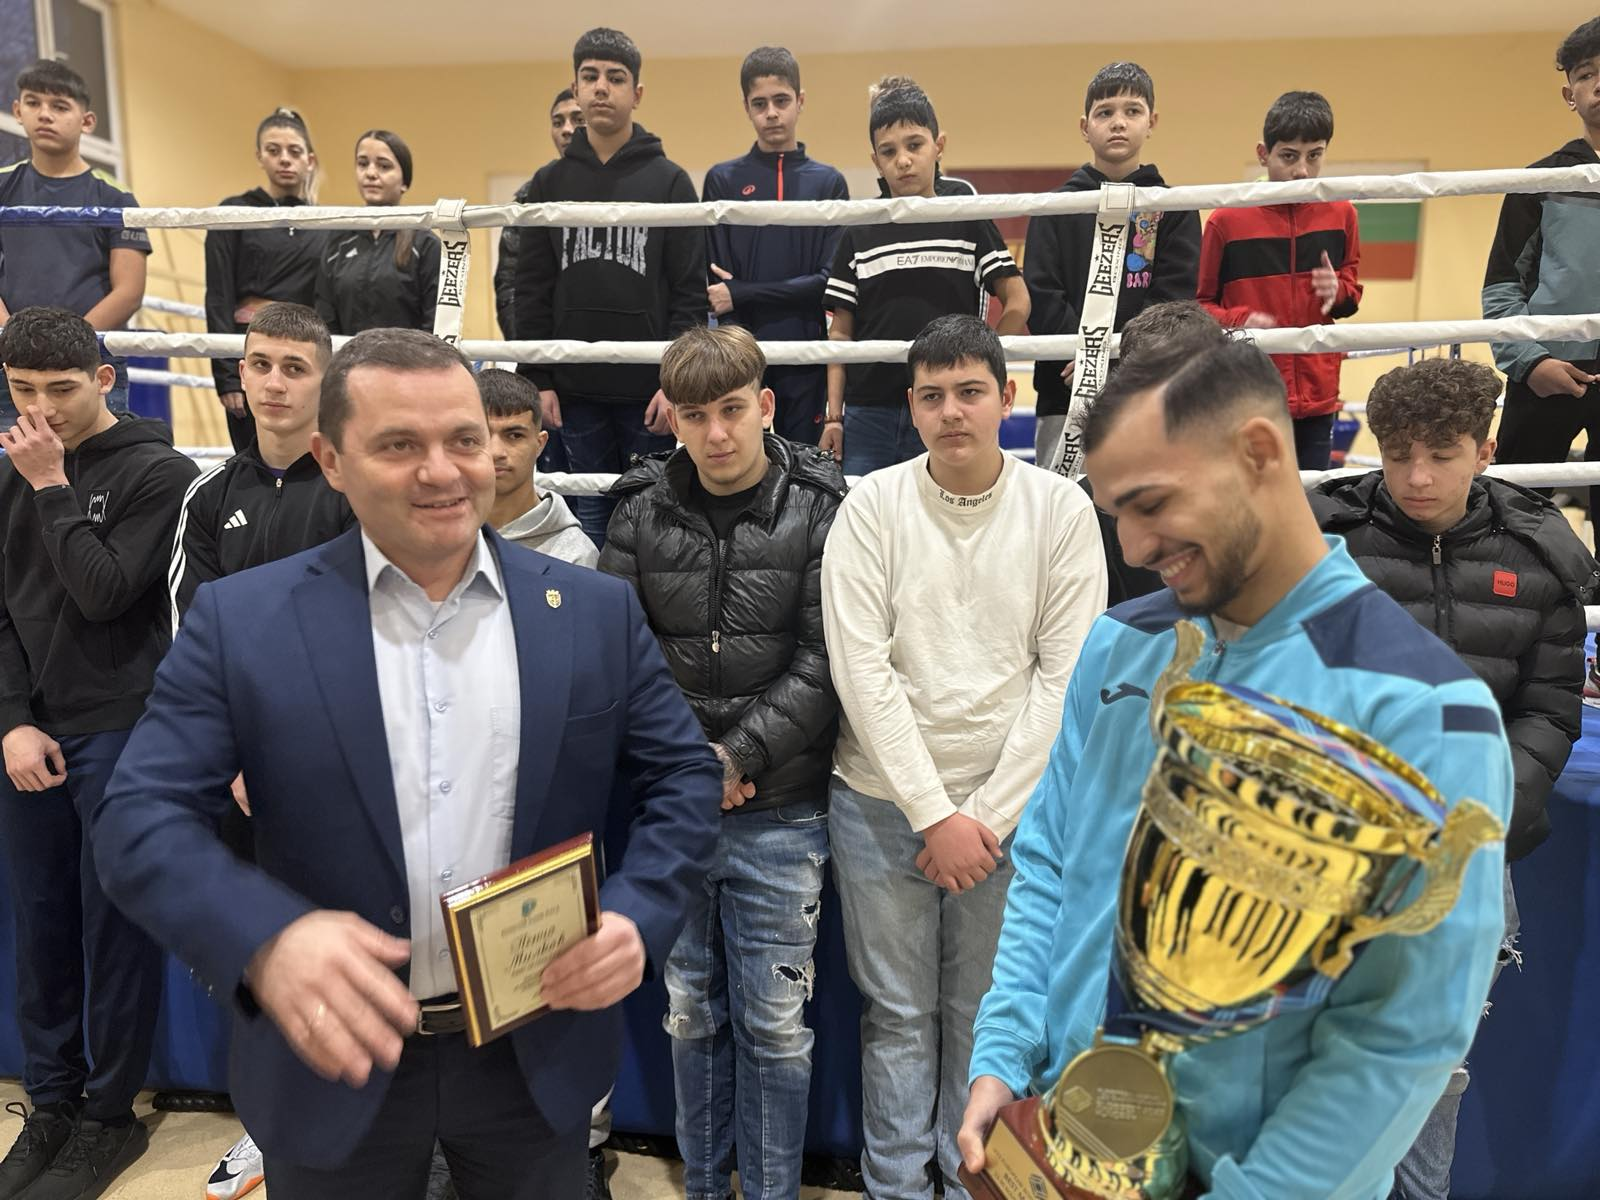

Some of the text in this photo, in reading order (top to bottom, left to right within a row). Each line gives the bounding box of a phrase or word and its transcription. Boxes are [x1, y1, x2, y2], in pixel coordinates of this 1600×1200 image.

[437, 240, 468, 307] GEEZERS
[897, 255, 920, 266] EA7
[1088, 222, 1125, 296] GEEZERS
[1074, 326, 1109, 399] GEEZERS
[940, 489, 954, 504] Los
